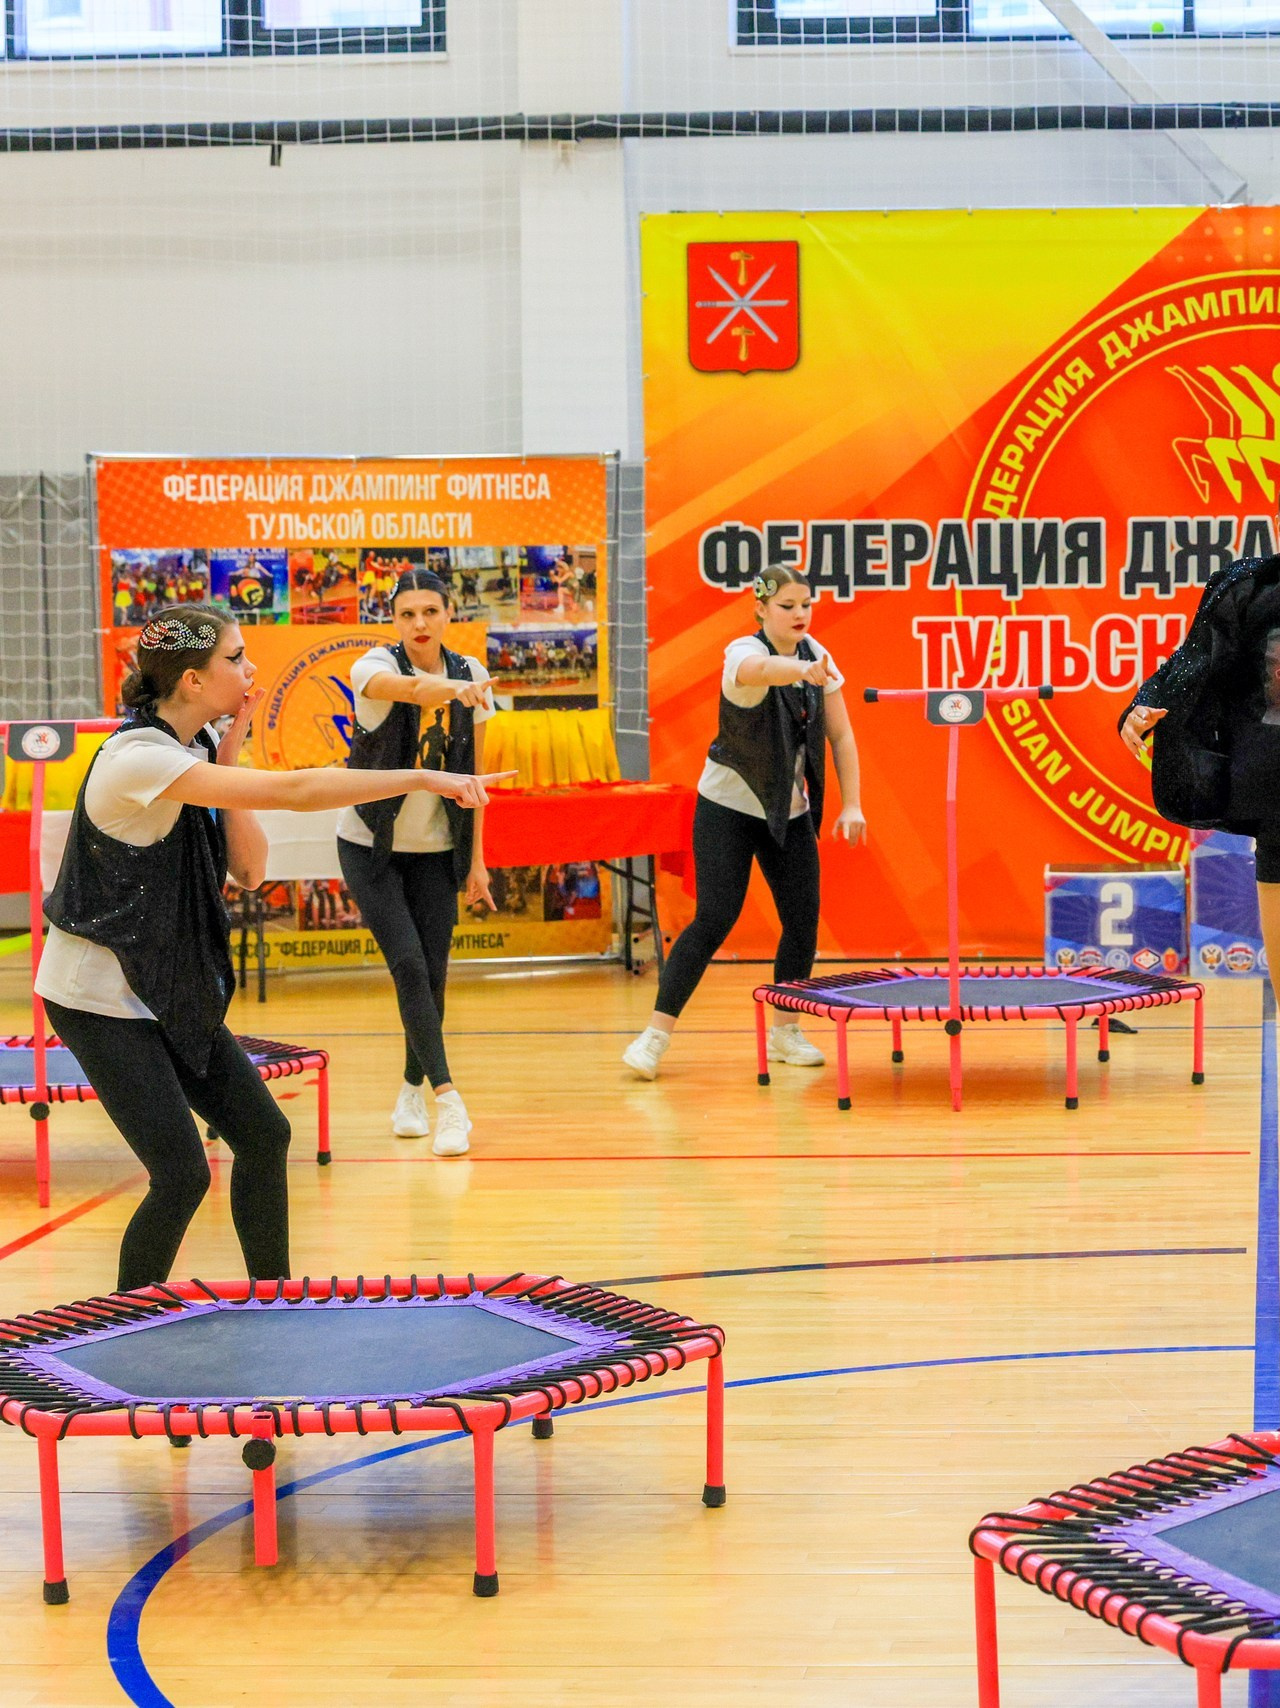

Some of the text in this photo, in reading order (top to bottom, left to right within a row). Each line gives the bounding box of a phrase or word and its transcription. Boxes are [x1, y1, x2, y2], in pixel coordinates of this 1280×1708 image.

[982, 356, 1096, 520] ДЕРАЦИЯ
[163, 473, 551, 504] ФЕДЕРАЦИЯ ДЖАМПИНГ ФИТНЕСА
[247, 508, 473, 541] ТУЛЬСКОЙ ОБЛАСТИ
[700, 517, 1105, 602] ФЕДЕРАЦИЯ
[267, 639, 380, 731] ФЕДЕРАЦИЯ ДЖАМПИНГ
[914, 614, 1188, 692] ТУЛЬСК
[1001, 698, 1073, 786] SIAN
[1068, 787, 1192, 867] JUMPI
[1101, 882, 1133, 946] 2
